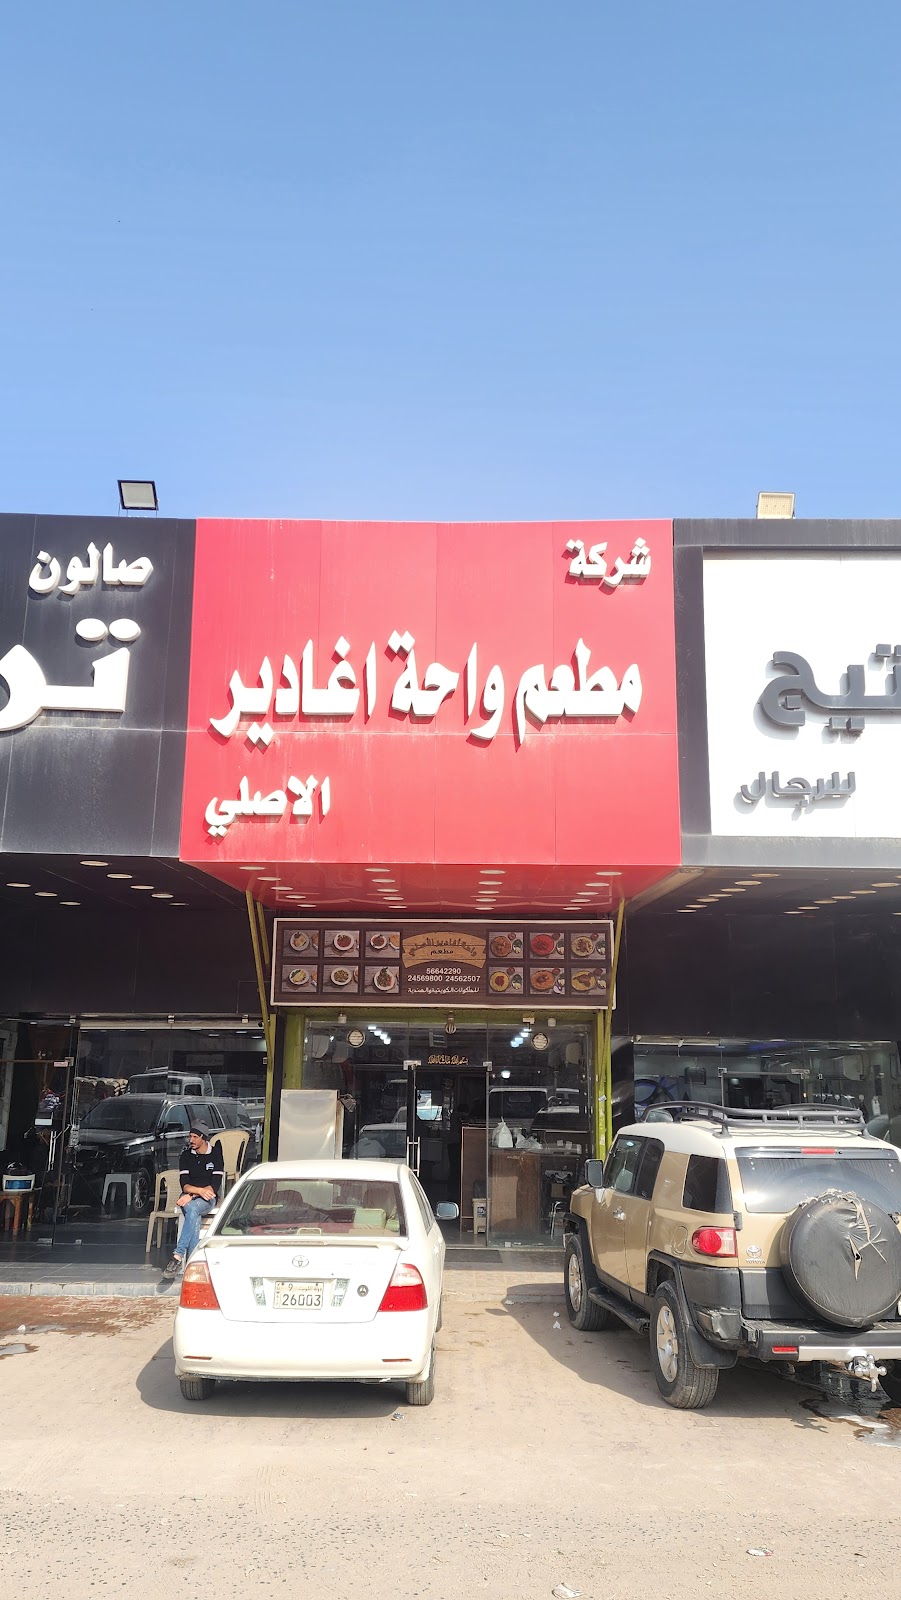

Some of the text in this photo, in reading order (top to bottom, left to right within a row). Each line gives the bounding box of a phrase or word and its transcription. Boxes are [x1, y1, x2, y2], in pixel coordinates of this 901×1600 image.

[29, 541, 154, 596] صالون
[565, 537, 652, 588] شركة
[209, 629, 643, 748] مطعم واحة اغادير
[204, 774, 331, 838] الاصلي
[740, 770, 857, 808] للرجال
[426, 967, 462, 975] 56642290
[430, 948, 454, 956] مطعم
[282, 1293, 321, 1306] 26003
